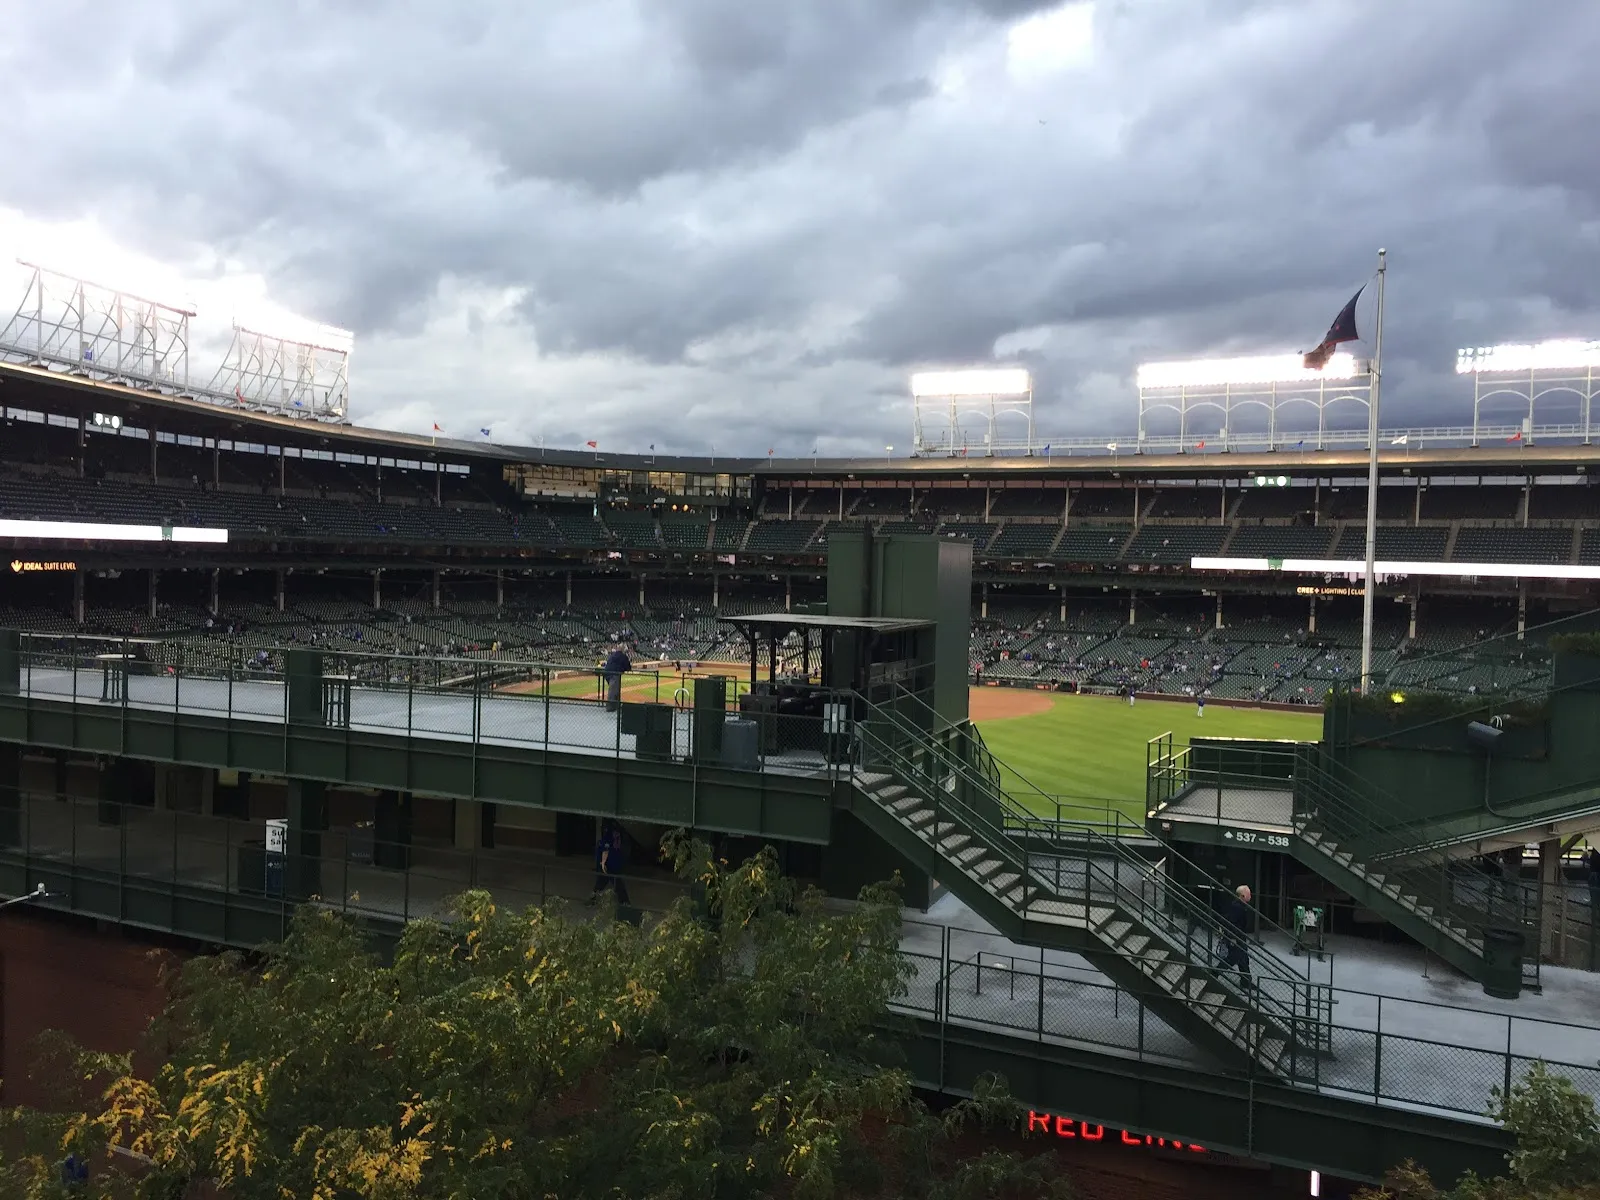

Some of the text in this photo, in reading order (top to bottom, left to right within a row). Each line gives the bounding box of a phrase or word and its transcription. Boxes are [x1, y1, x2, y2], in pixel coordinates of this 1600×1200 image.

[23, 562, 76, 570] IDEAL SUITE LEVEL
[1297, 586, 1314, 594] CREE
[1321, 587, 1347, 595] LIGHTING
[1236, 831, 1257, 843] 537
[1268, 835, 1289, 847] 538
[1028, 1110, 1104, 1140] RED
